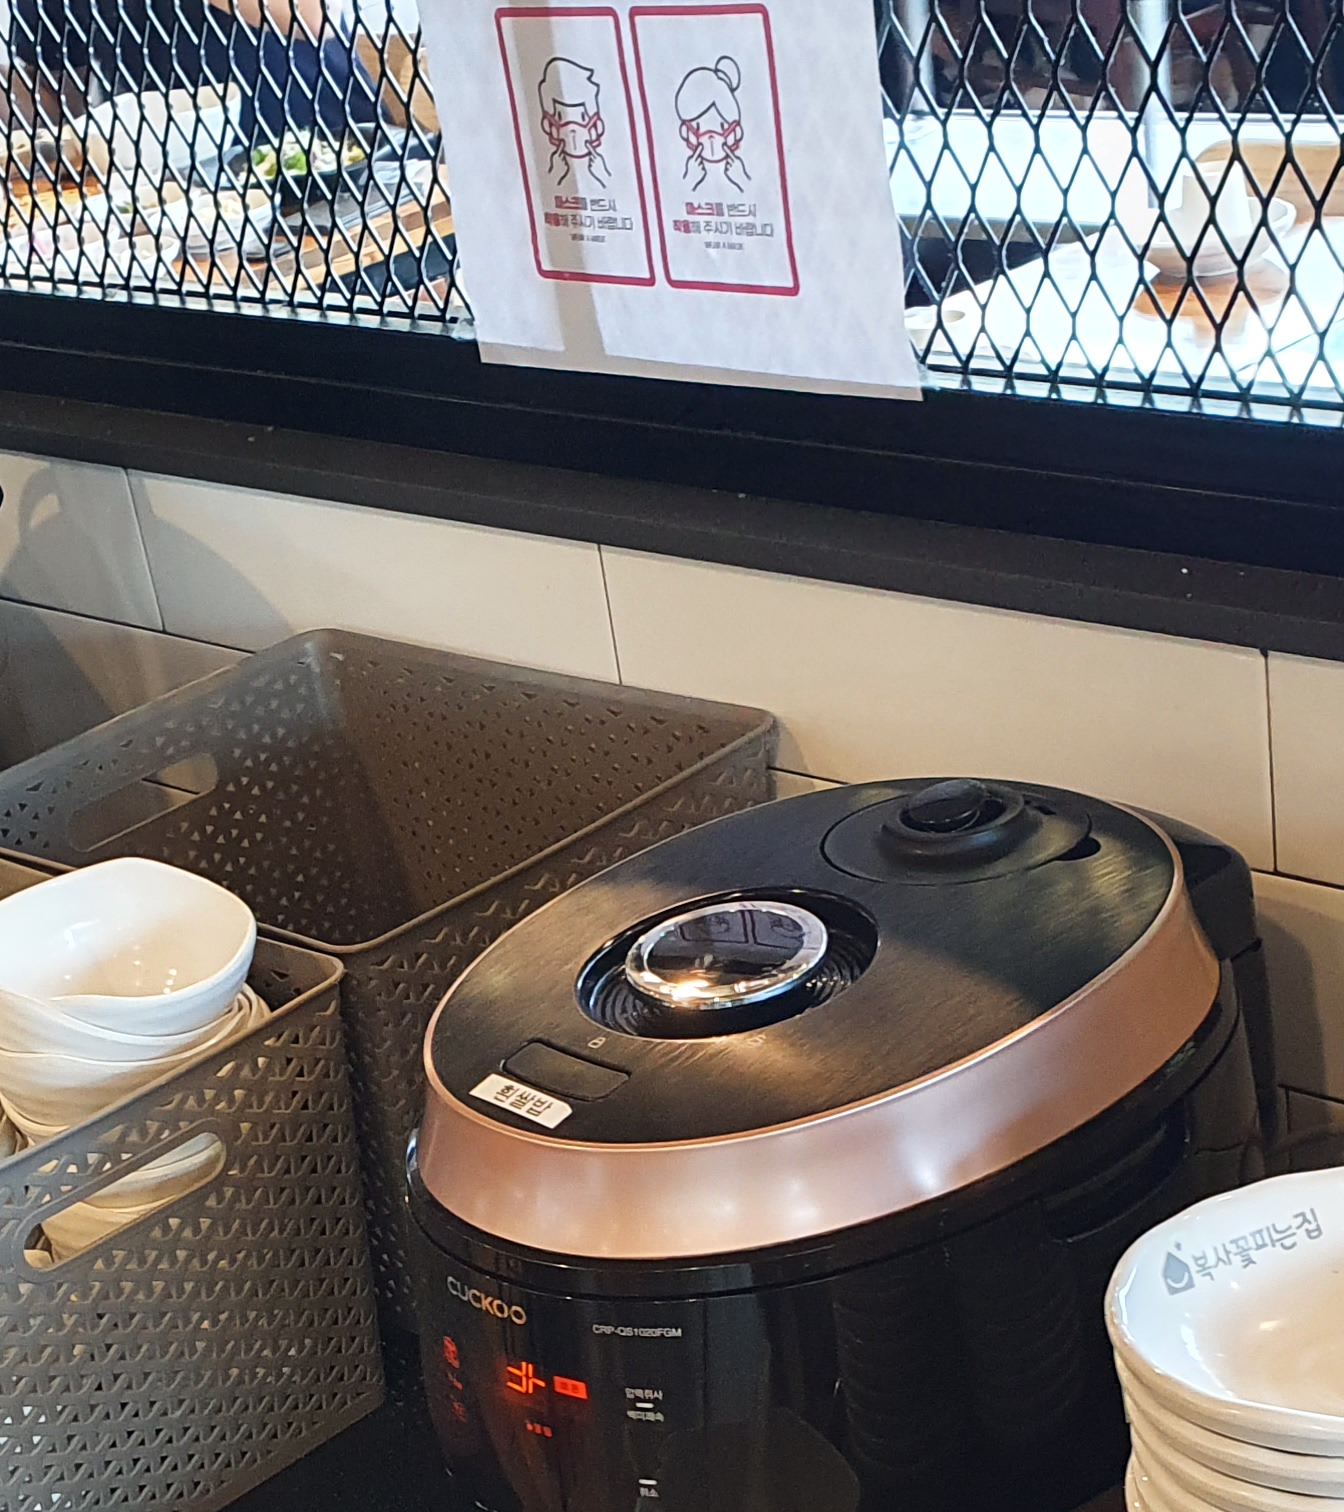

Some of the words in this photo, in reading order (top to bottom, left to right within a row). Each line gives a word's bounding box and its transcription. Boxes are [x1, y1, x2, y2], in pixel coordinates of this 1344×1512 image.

[493, 1084, 554, 1117] 흰쌀밥
[1191, 1207, 1323, 1281] 복사꽃피는집
[446, 1275, 527, 1325] CUCKOO
